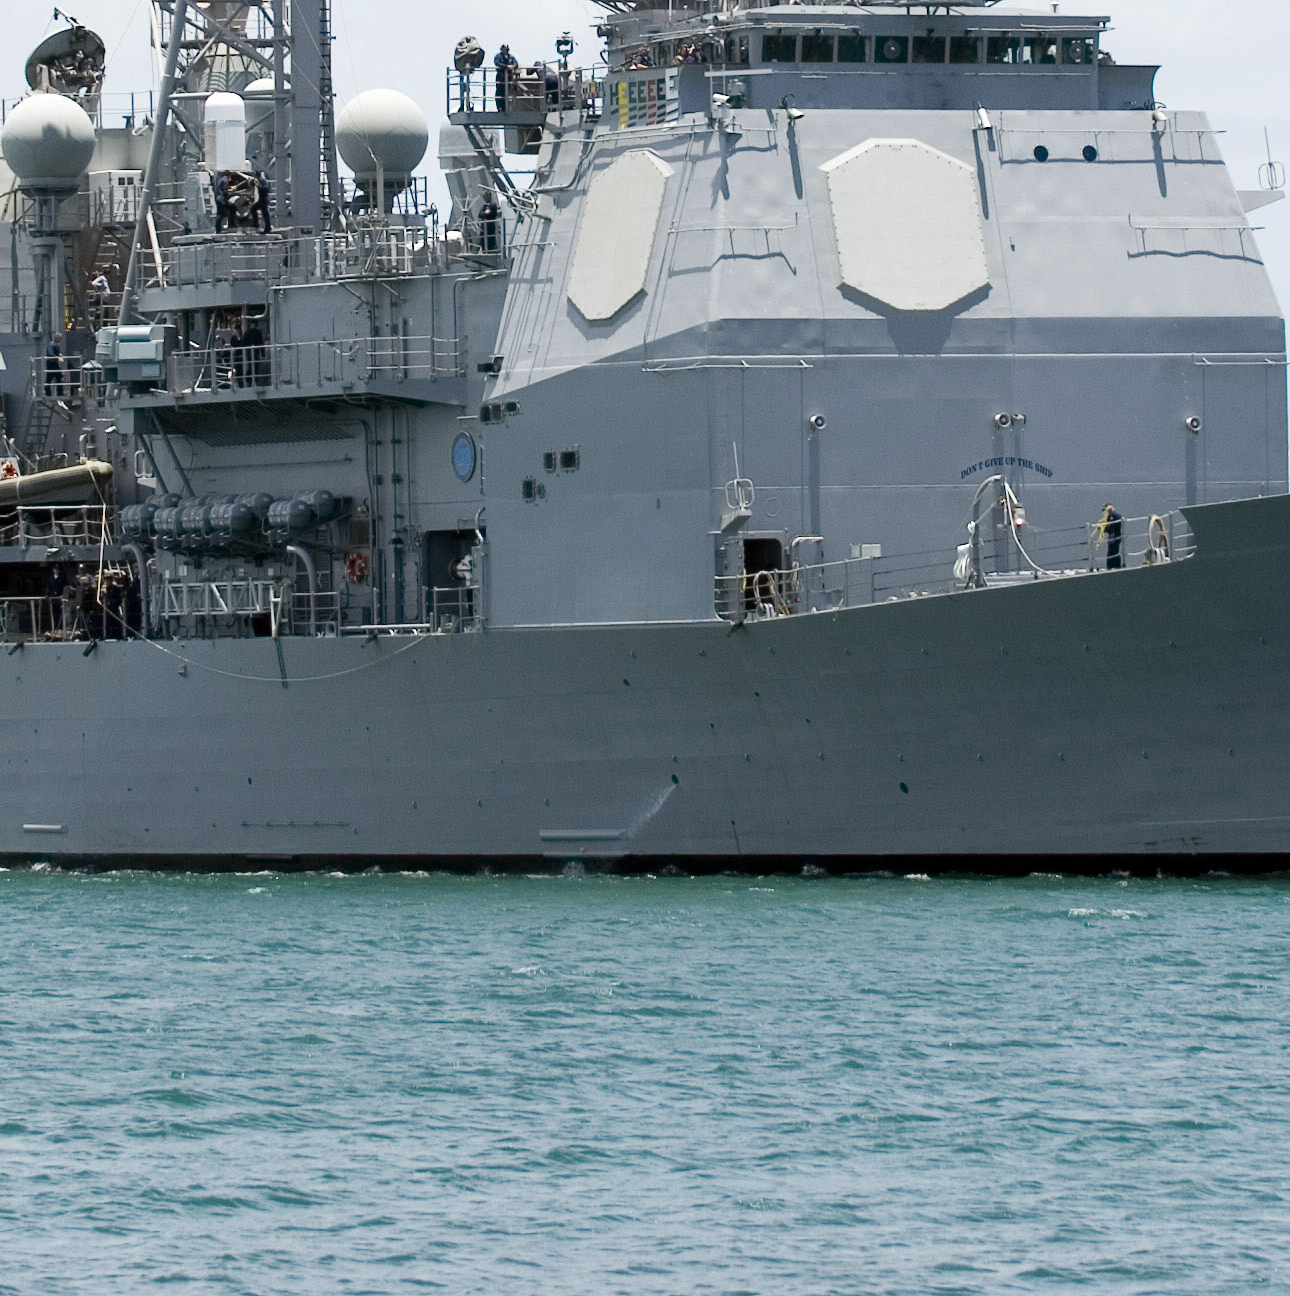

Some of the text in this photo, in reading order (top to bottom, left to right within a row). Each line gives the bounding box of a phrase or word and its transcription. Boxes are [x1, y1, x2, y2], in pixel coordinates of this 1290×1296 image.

[985, 457, 1004, 468] GIVE
[1005, 457, 1016, 465] UP
[1017, 458, 1034, 469] THE
[1035, 463, 1053, 478] SHIP
